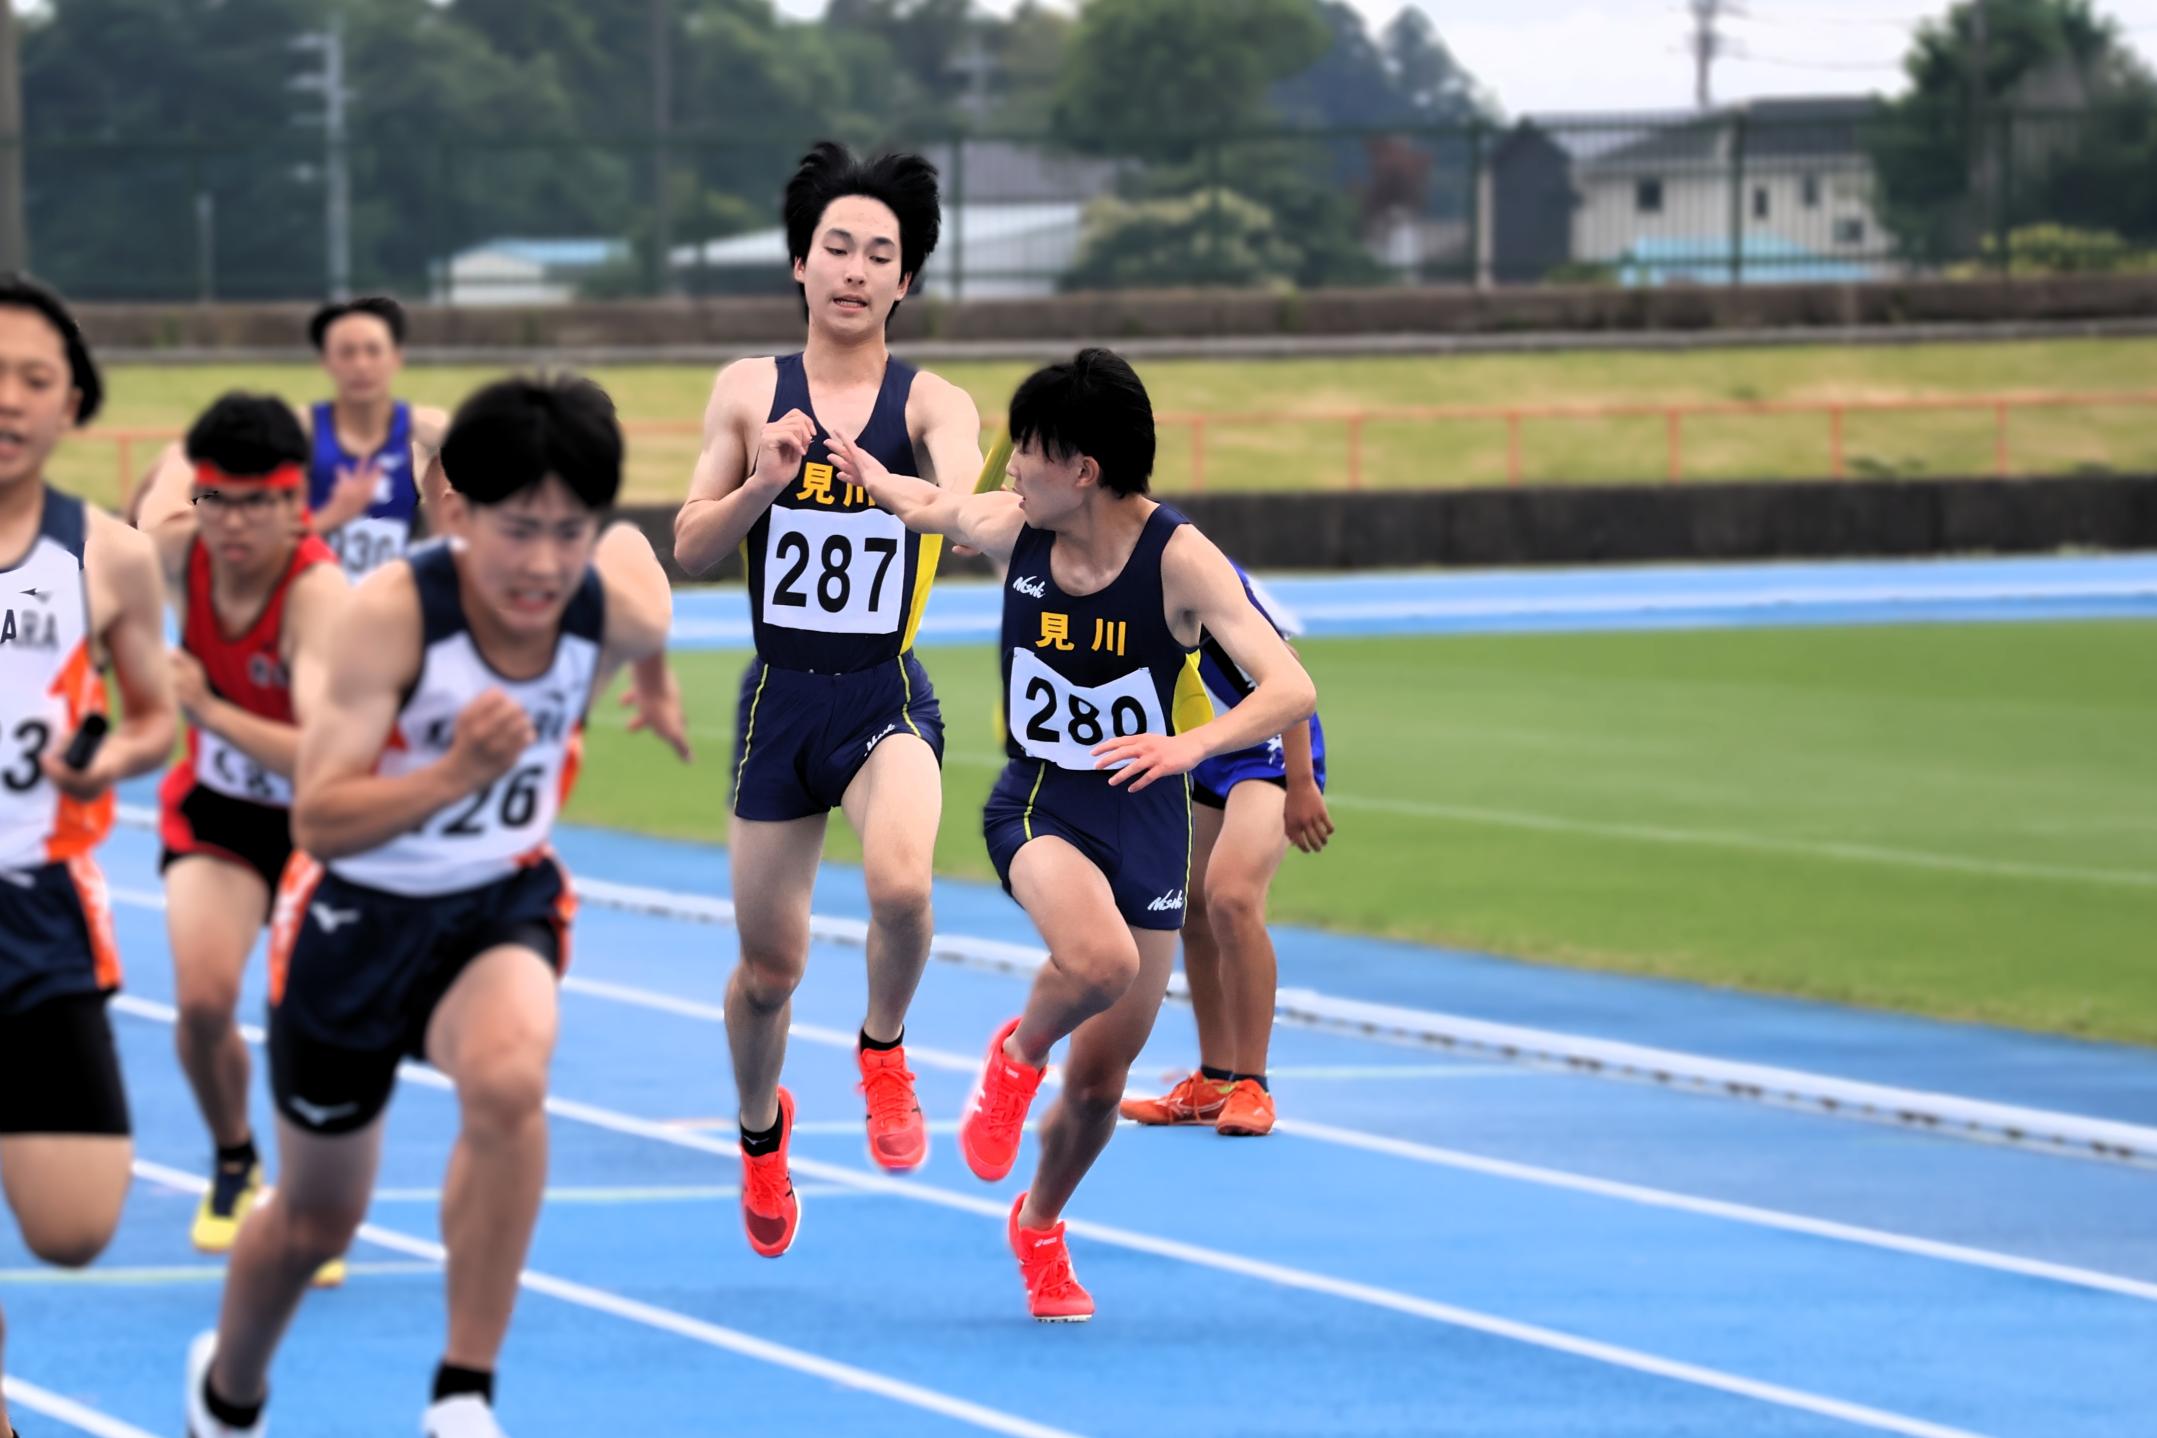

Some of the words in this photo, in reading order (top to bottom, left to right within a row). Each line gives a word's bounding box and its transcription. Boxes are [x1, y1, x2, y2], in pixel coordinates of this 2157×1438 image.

[772, 531, 898, 613] 287
[1035, 611, 1127, 656] 見川
[1025, 676, 1148, 746] 280
